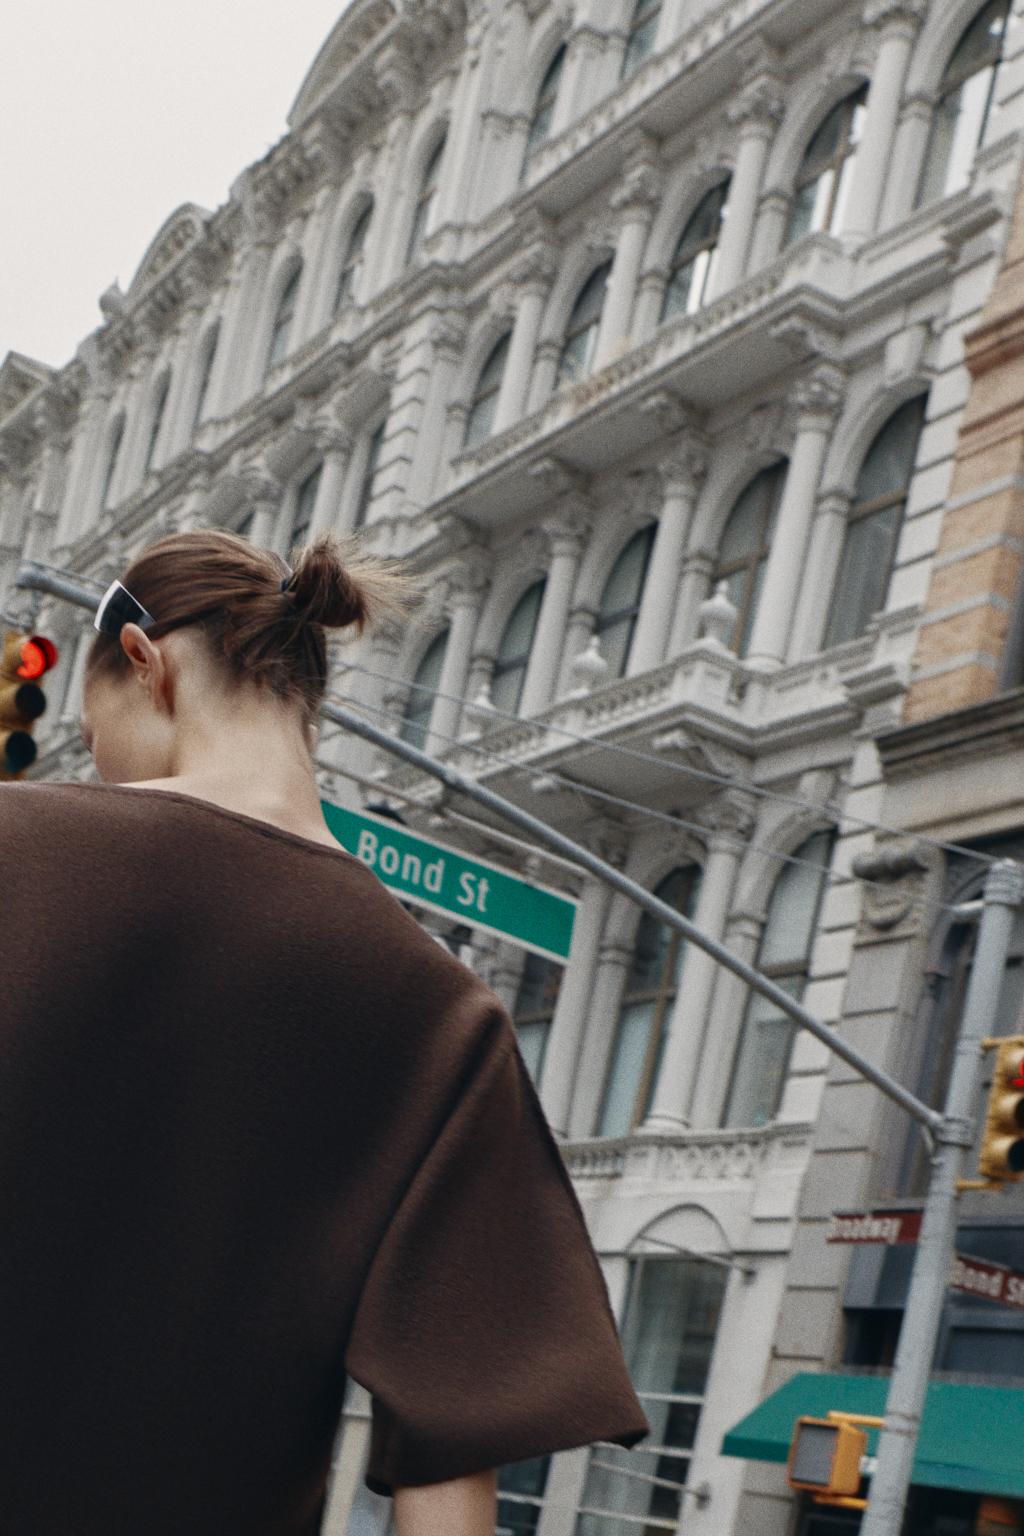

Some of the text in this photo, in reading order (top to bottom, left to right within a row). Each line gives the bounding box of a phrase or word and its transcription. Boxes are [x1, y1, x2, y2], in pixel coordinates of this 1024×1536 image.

[356, 829, 490, 912] Bond St
[827, 1215, 903, 1245] Broadway
